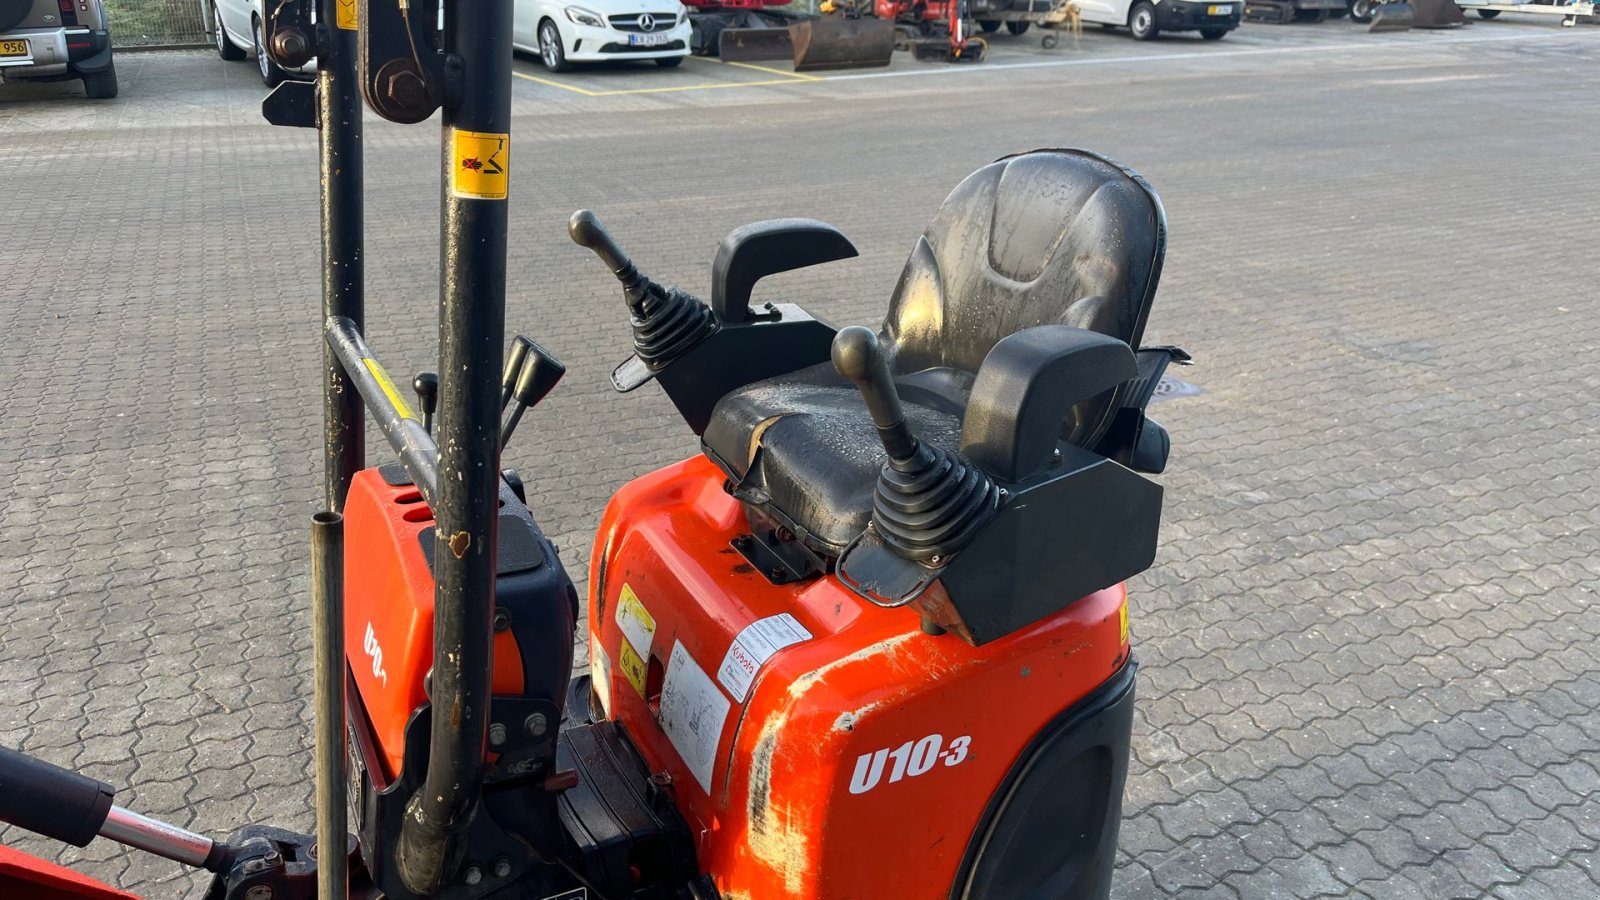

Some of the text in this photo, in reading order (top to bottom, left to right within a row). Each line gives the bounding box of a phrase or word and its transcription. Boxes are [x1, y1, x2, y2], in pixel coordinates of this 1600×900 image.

[3, 43, 24, 52] 956
[732, 644, 755, 675] Kubota
[849, 734, 972, 794] U10-3
